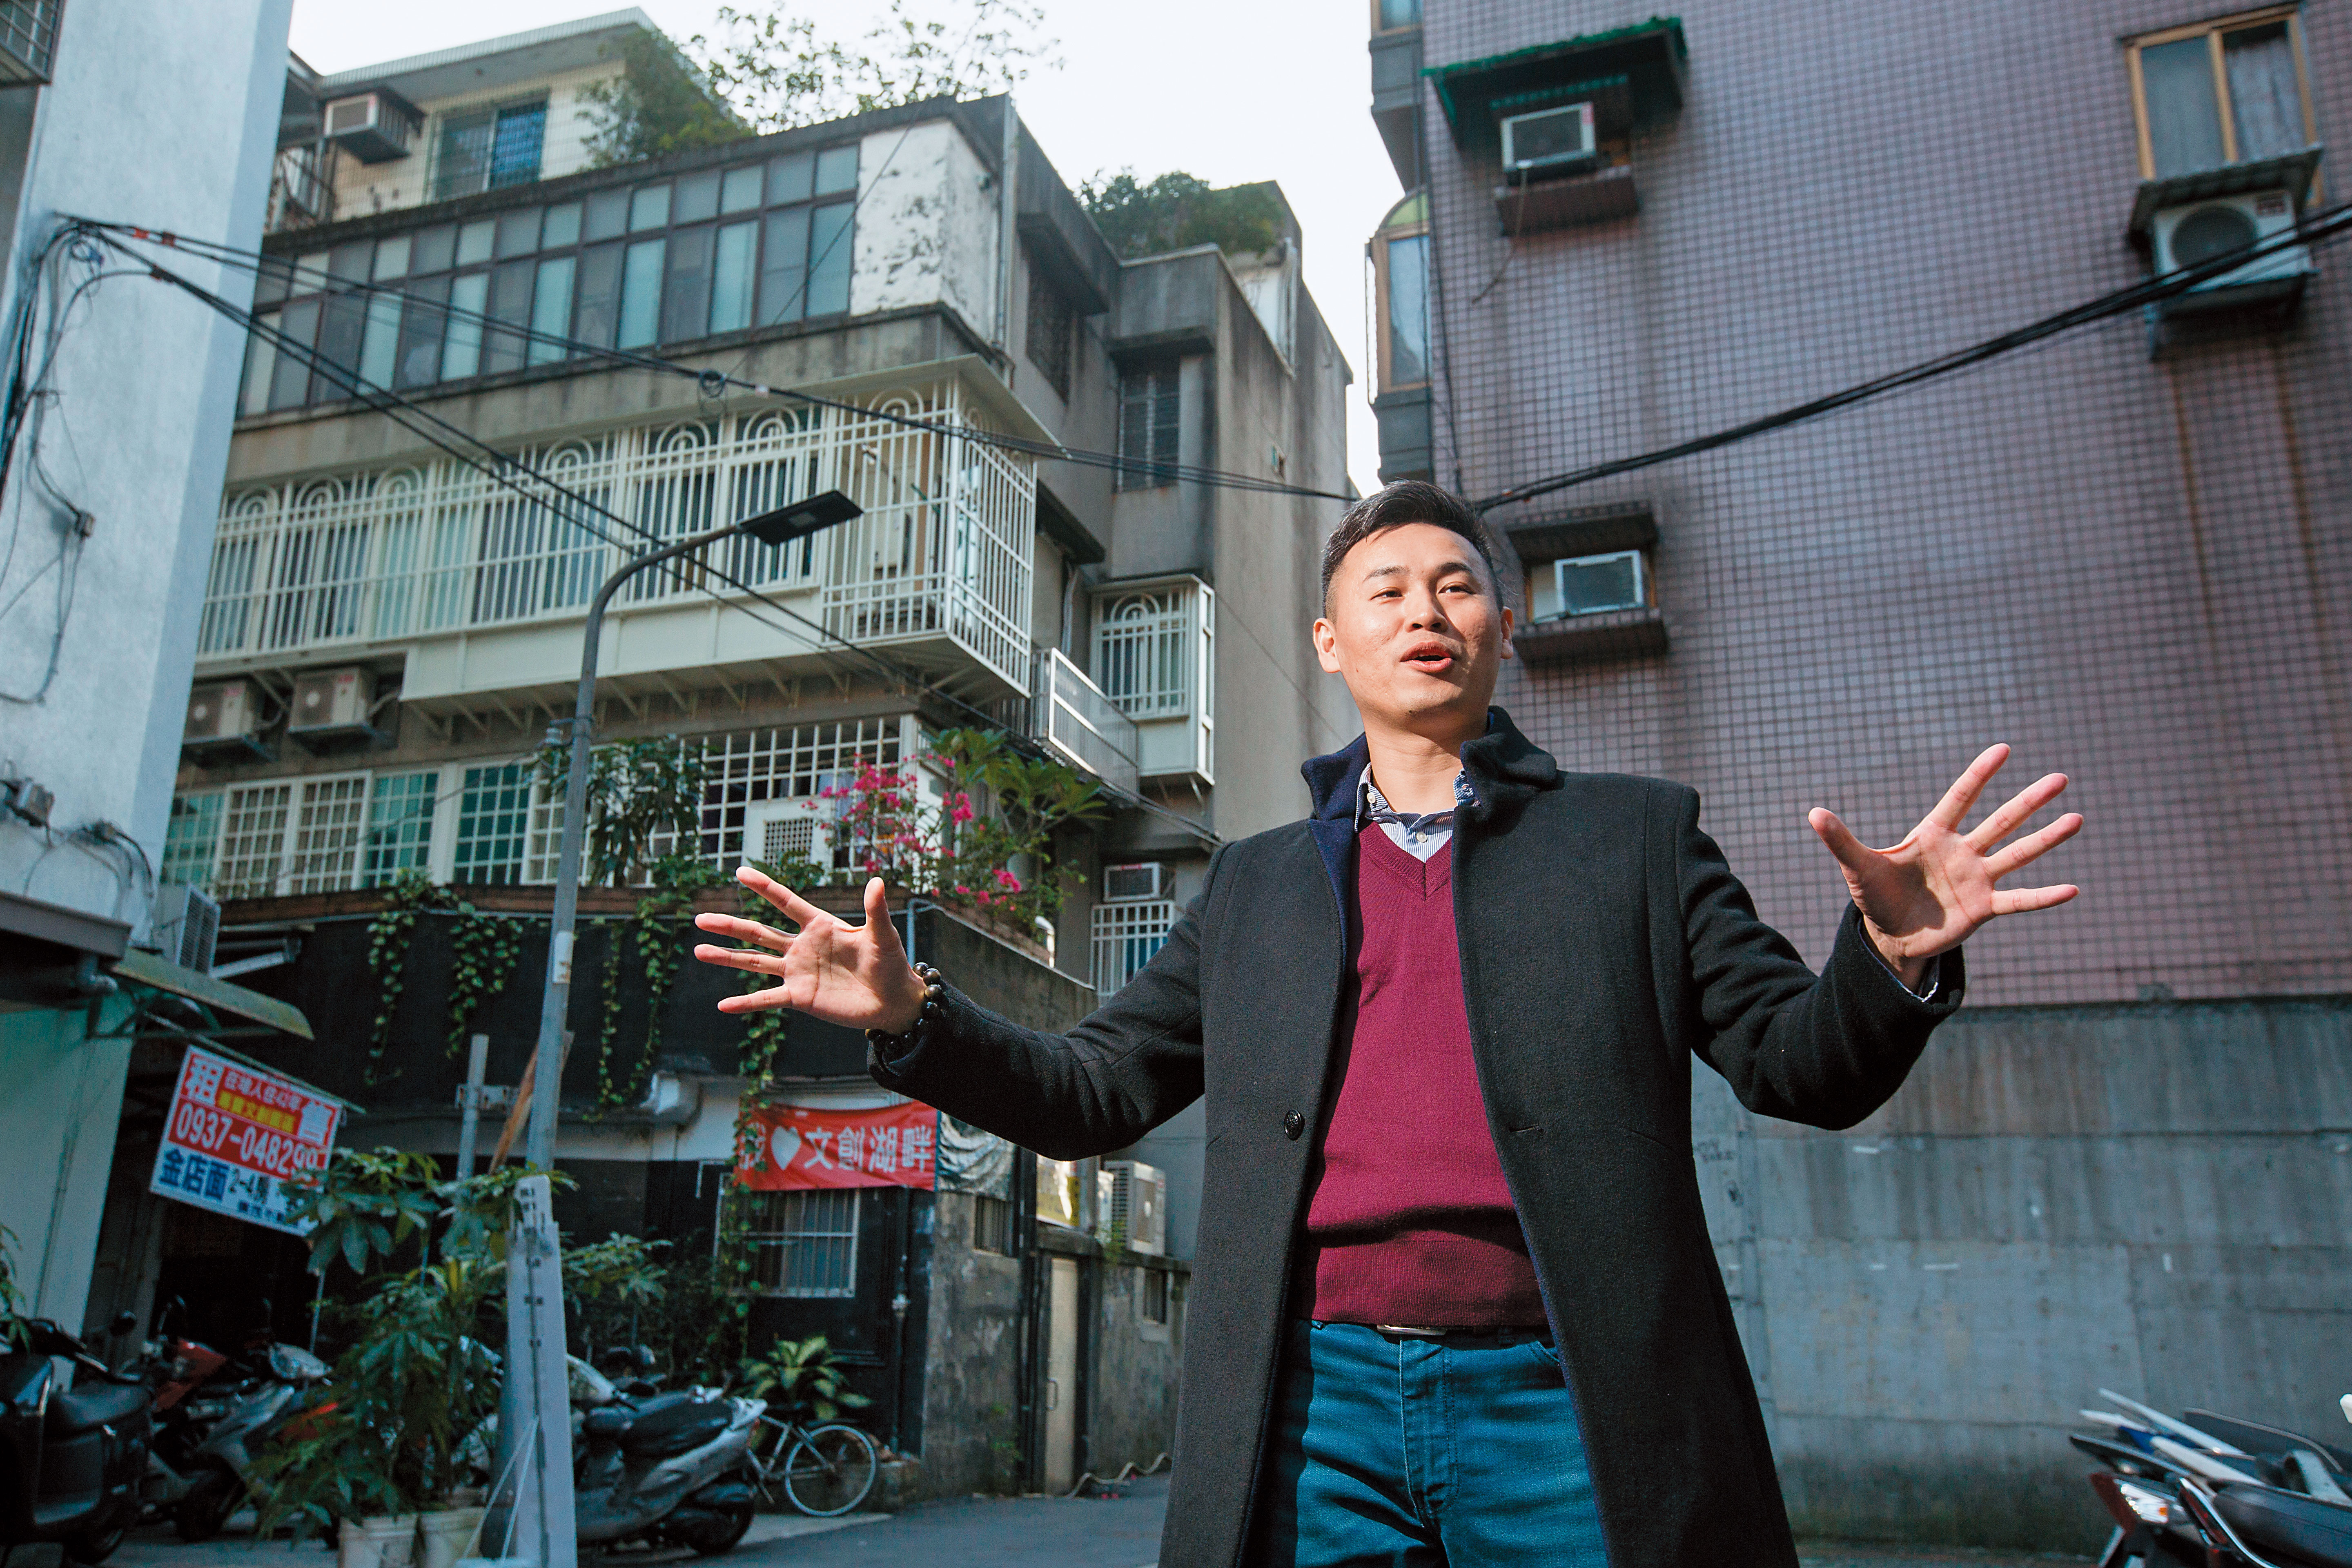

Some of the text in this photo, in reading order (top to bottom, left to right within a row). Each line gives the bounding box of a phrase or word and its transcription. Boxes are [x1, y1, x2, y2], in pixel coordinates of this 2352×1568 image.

[804, 1125, 932, 1173] 文創湖畔
[159, 1148, 229, 1201] 金店面
